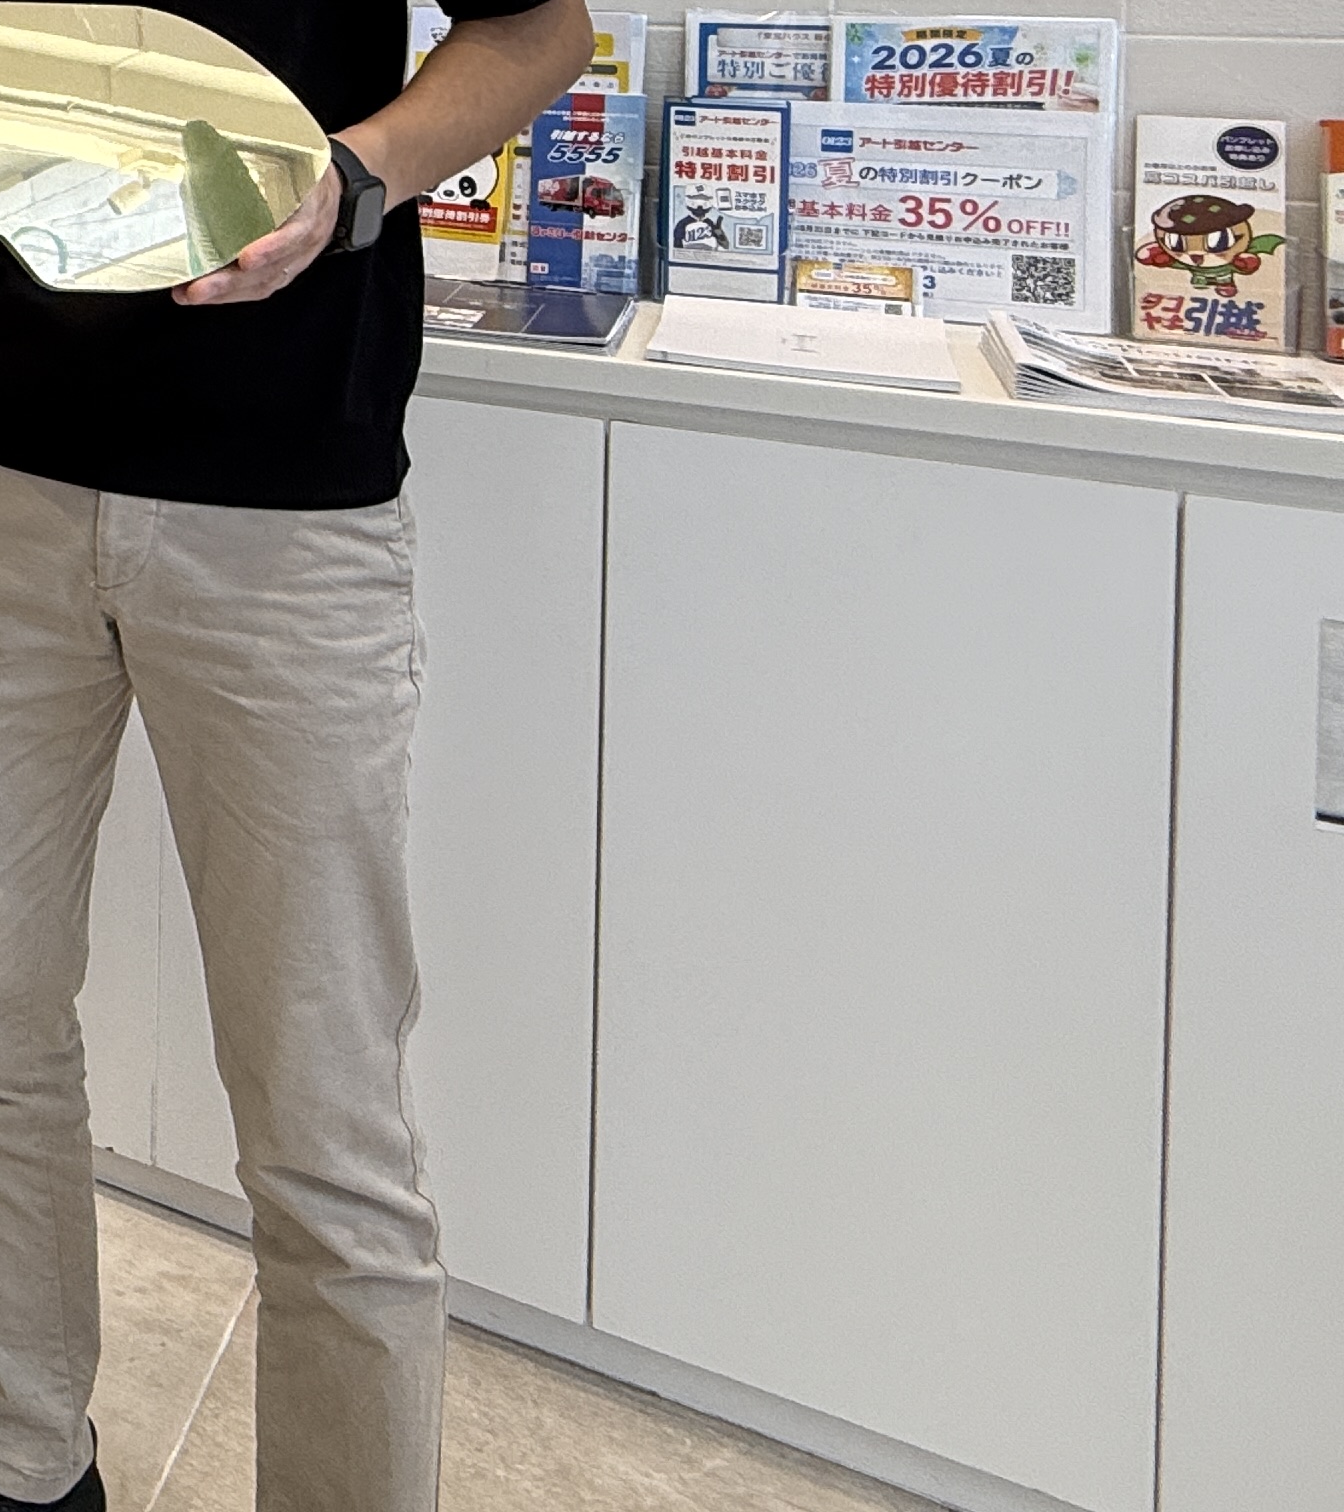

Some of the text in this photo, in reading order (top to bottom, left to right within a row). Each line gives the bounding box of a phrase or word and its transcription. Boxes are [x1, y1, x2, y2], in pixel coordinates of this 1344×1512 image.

[864, 68, 1075, 100] 特別優待割引!
[547, 143, 624, 165] 5555
[681, 146, 768, 161] 引越基本料金
[858, 137, 980, 152] アート引越センター
[674, 160, 776, 184] 特別割引
[790, 156, 1043, 190] 26夏の特別割引クーポン
